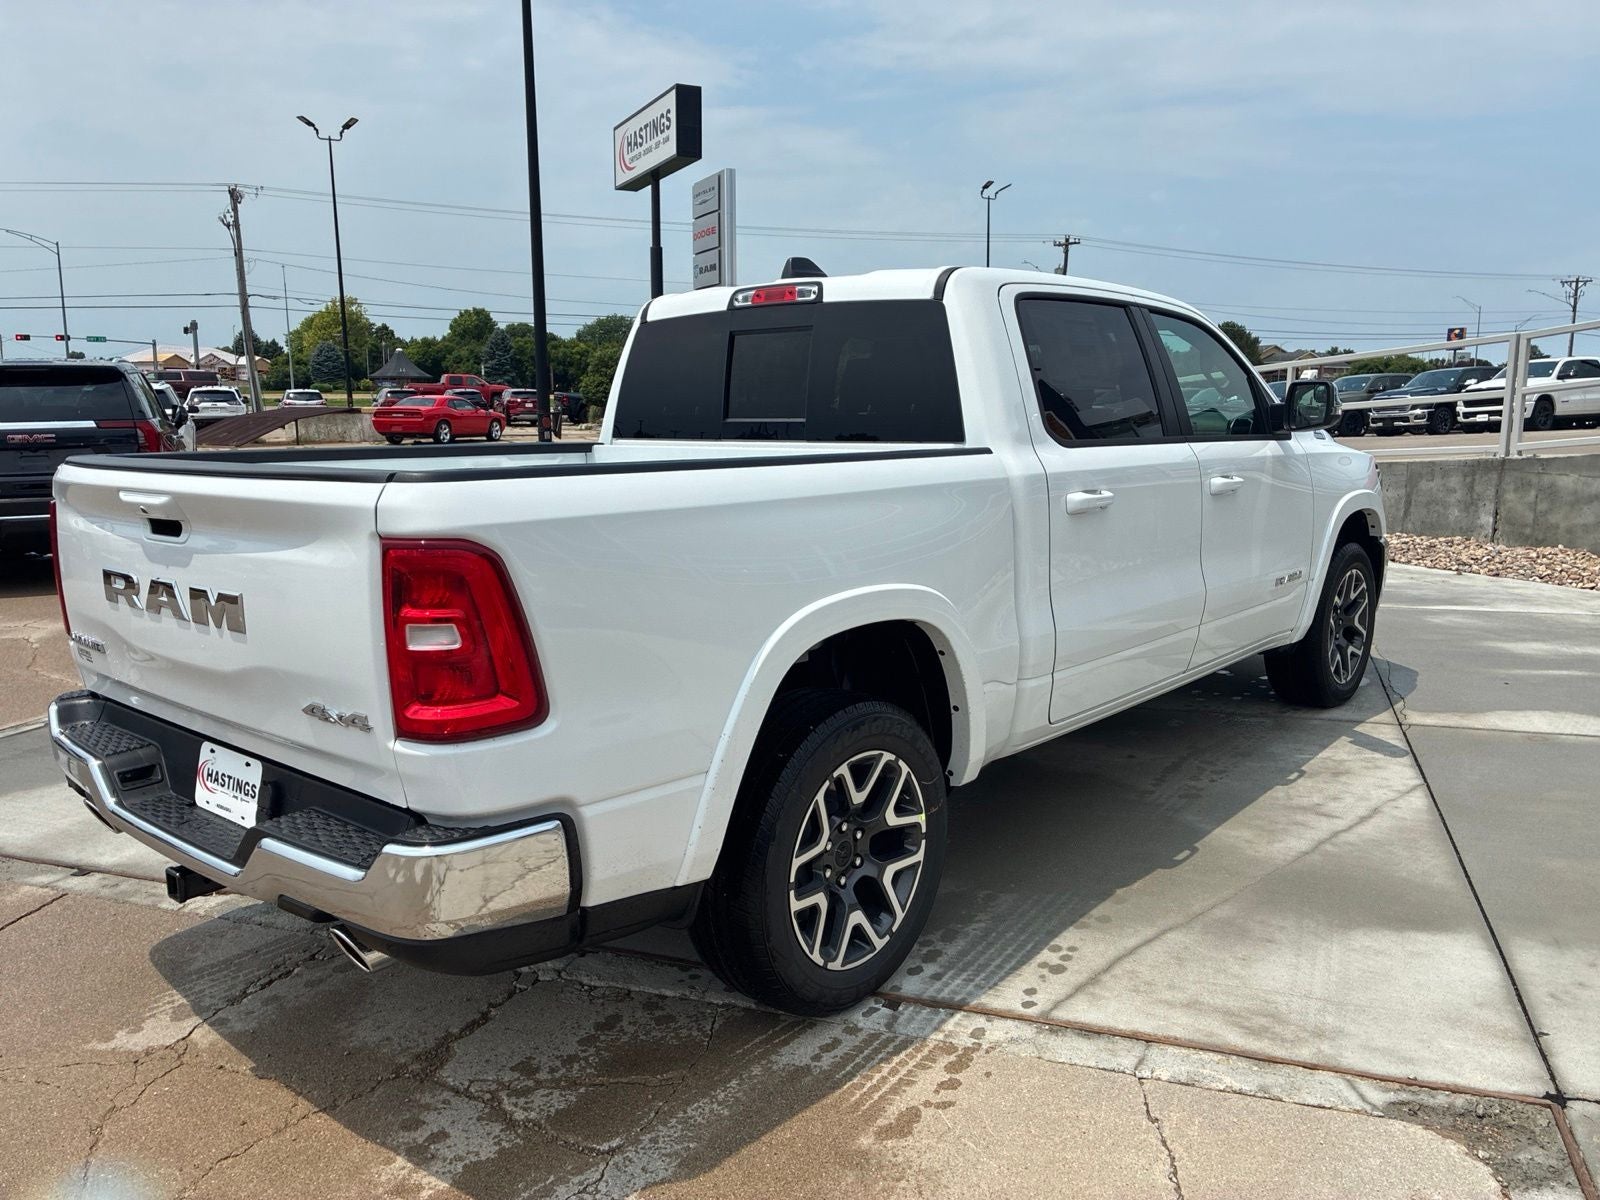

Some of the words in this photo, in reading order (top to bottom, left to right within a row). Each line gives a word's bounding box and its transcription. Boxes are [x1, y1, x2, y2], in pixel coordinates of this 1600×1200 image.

[627, 108, 672, 155] HASTINGS
[693, 226, 717, 241] DODGE
[699, 263, 717, 275] RAM
[102, 567, 247, 635] RAM
[206, 767, 257, 800] HASTINGS
